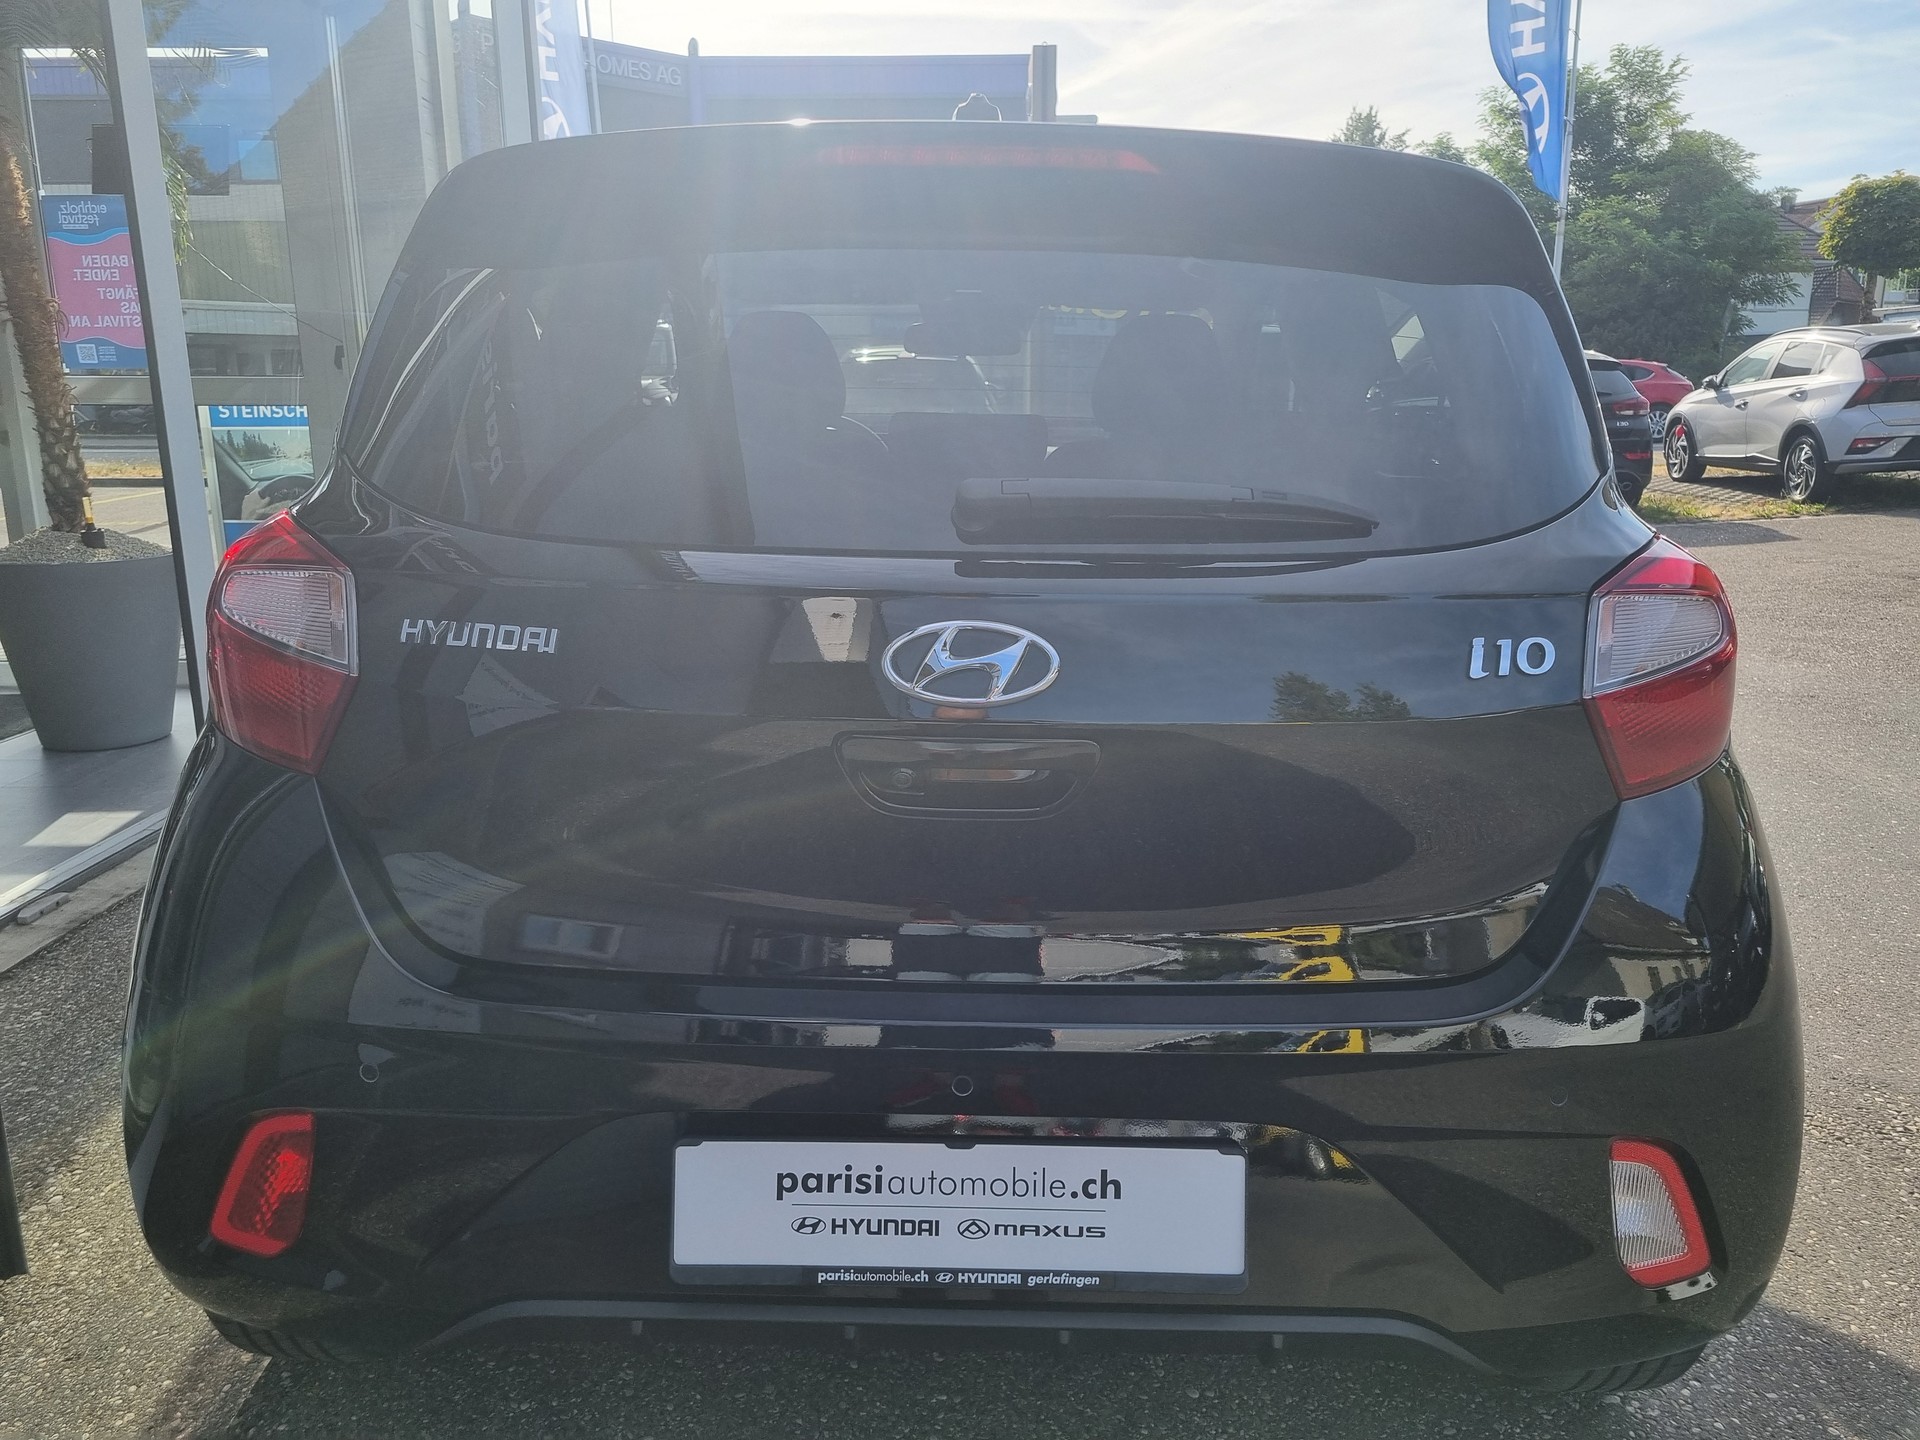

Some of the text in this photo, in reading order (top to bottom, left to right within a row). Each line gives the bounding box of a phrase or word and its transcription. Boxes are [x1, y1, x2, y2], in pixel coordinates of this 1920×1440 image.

[594, 53, 682, 86] OMES AG
[219, 405, 308, 418] STEINSCH
[400, 618, 559, 654] HYUNDAI
[1469, 636, 1556, 679] i10
[776, 1164, 1122, 1201] parisiautomobile.ch
[831, 1217, 1107, 1239] HYUNDAI MAXUS
[817, 1268, 1100, 1288] parisiautomobile.ch HYUNDAI gerlafingen
